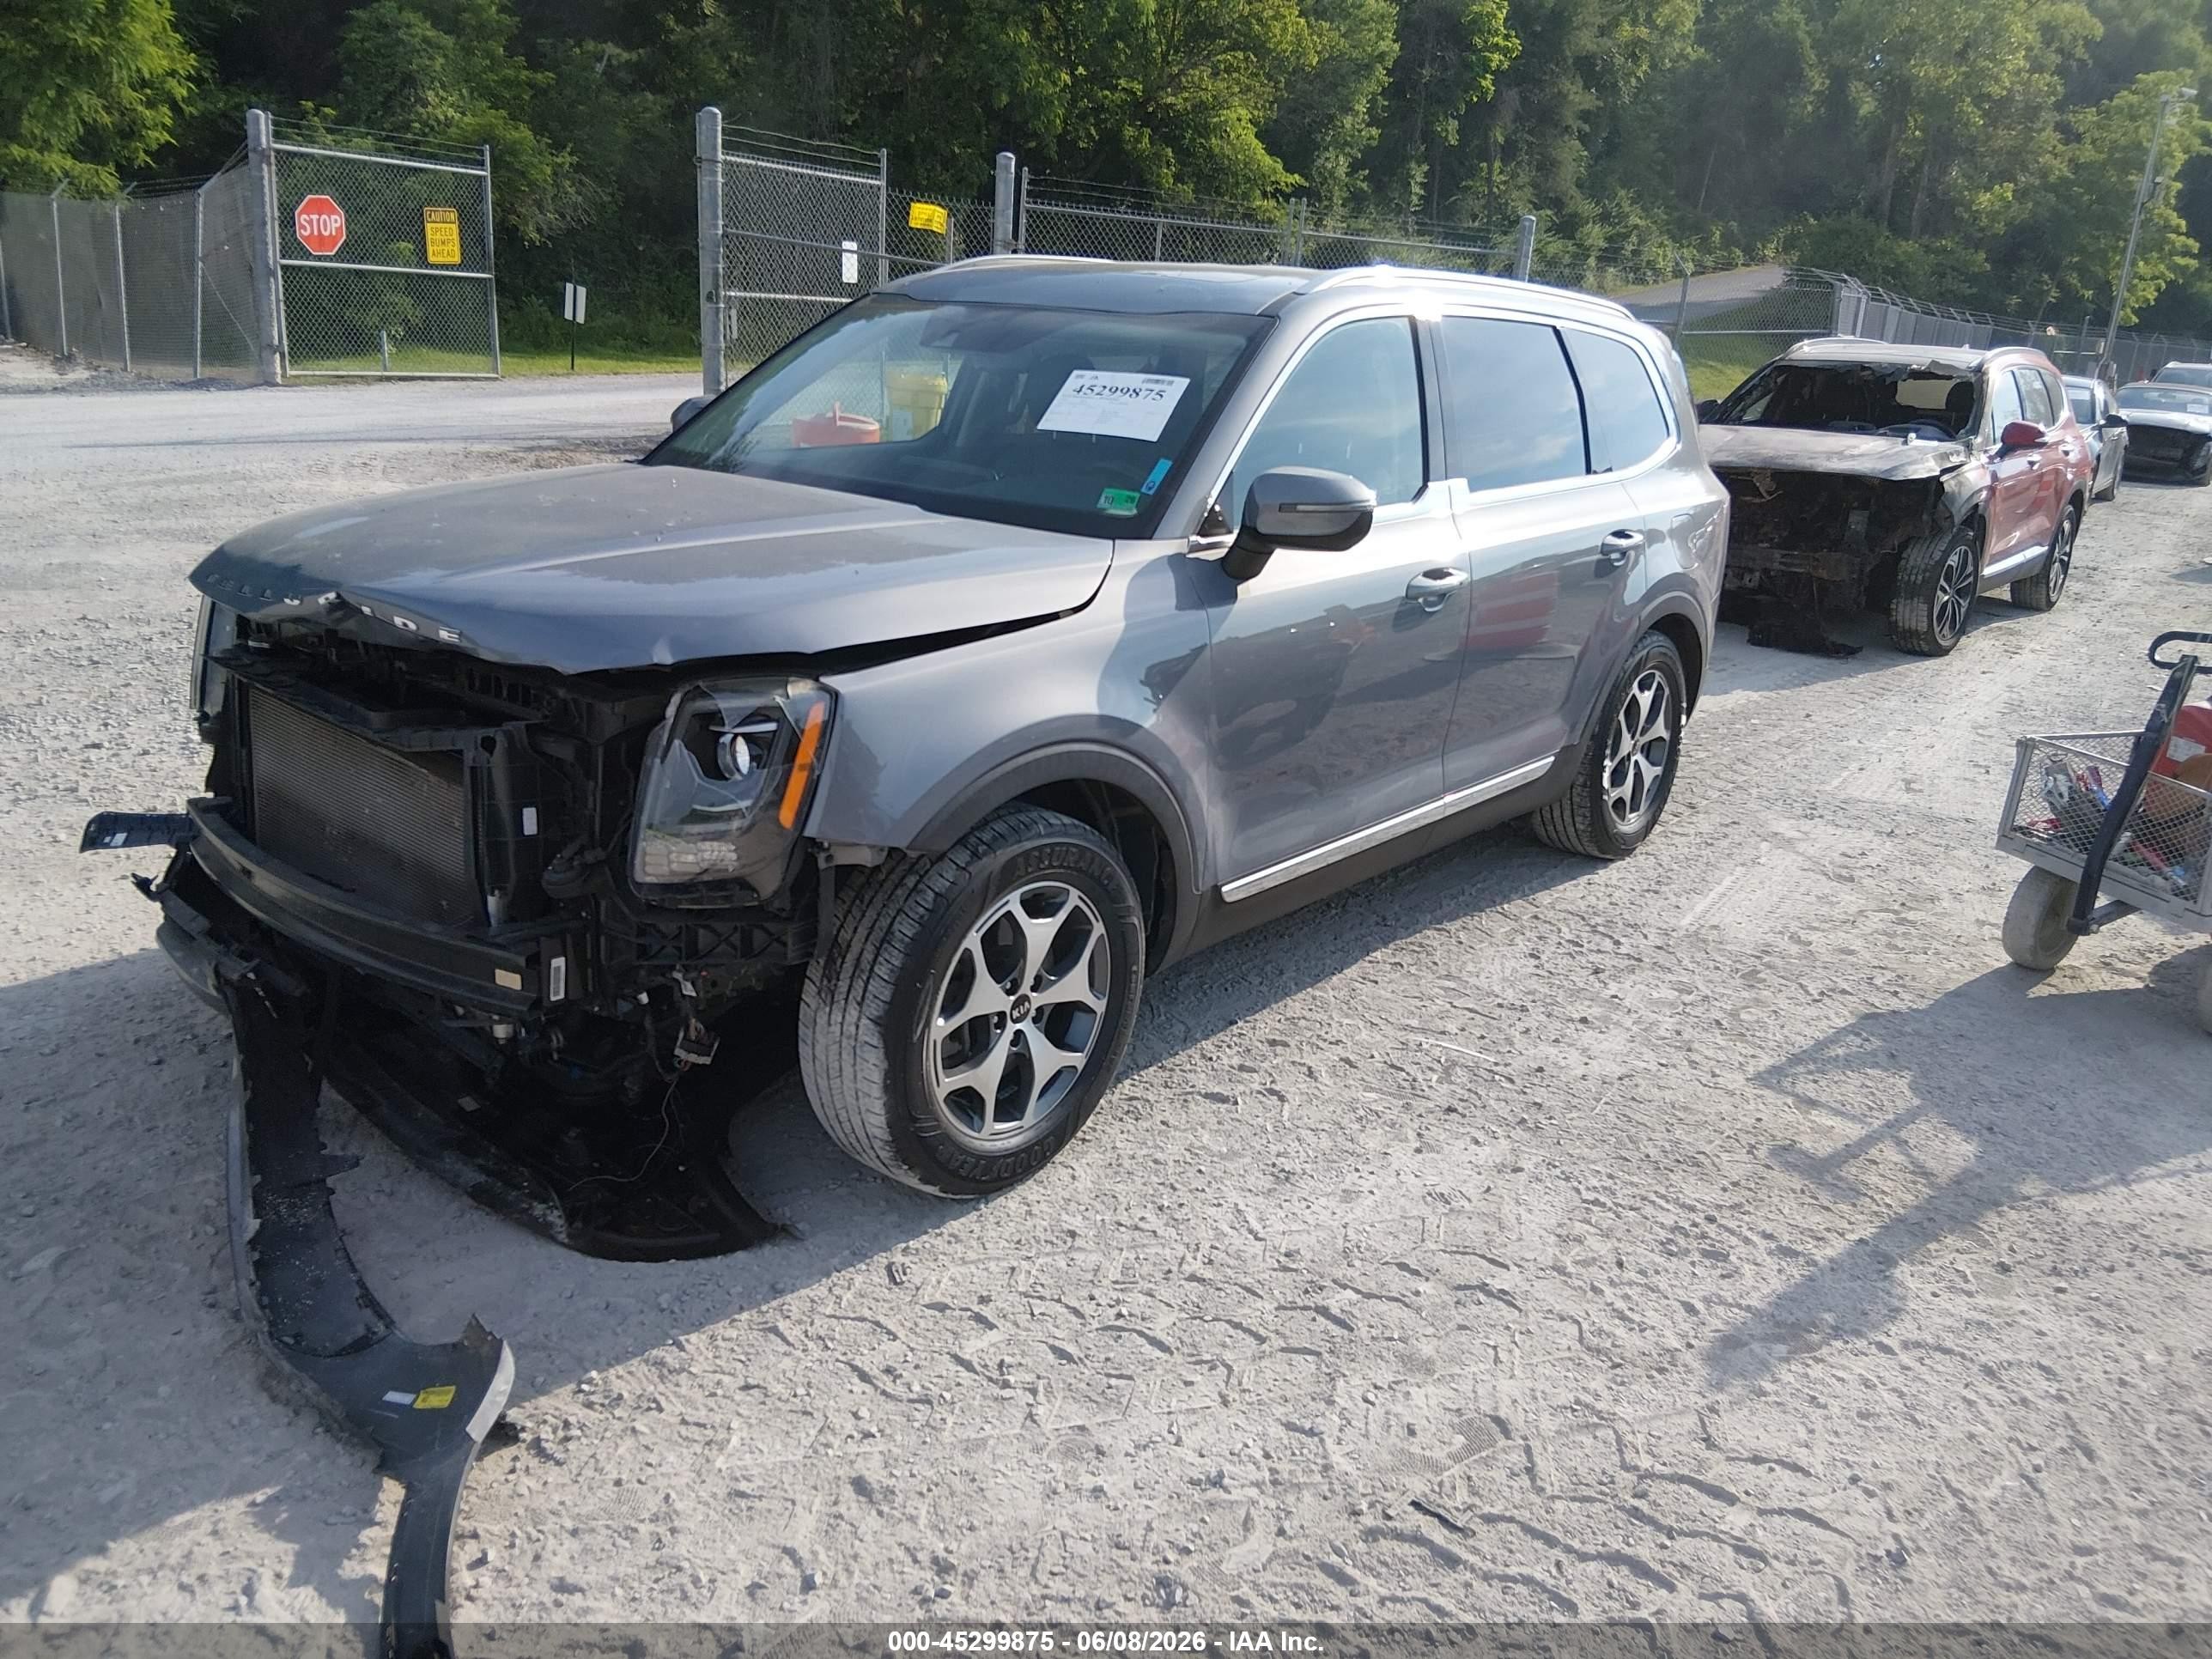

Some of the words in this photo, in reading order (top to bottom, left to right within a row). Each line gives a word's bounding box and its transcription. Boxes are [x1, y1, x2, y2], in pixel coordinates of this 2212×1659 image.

[426, 210, 455, 223] CAUTION
[300, 214, 341, 237] STOP
[429, 226, 453, 237] SPEED
[430, 237, 456, 248] BUMPS
[431, 247, 456, 258] AHEAD
[1073, 384, 1167, 402] 45299875
[1011, 1000, 1031, 1020] KIA
